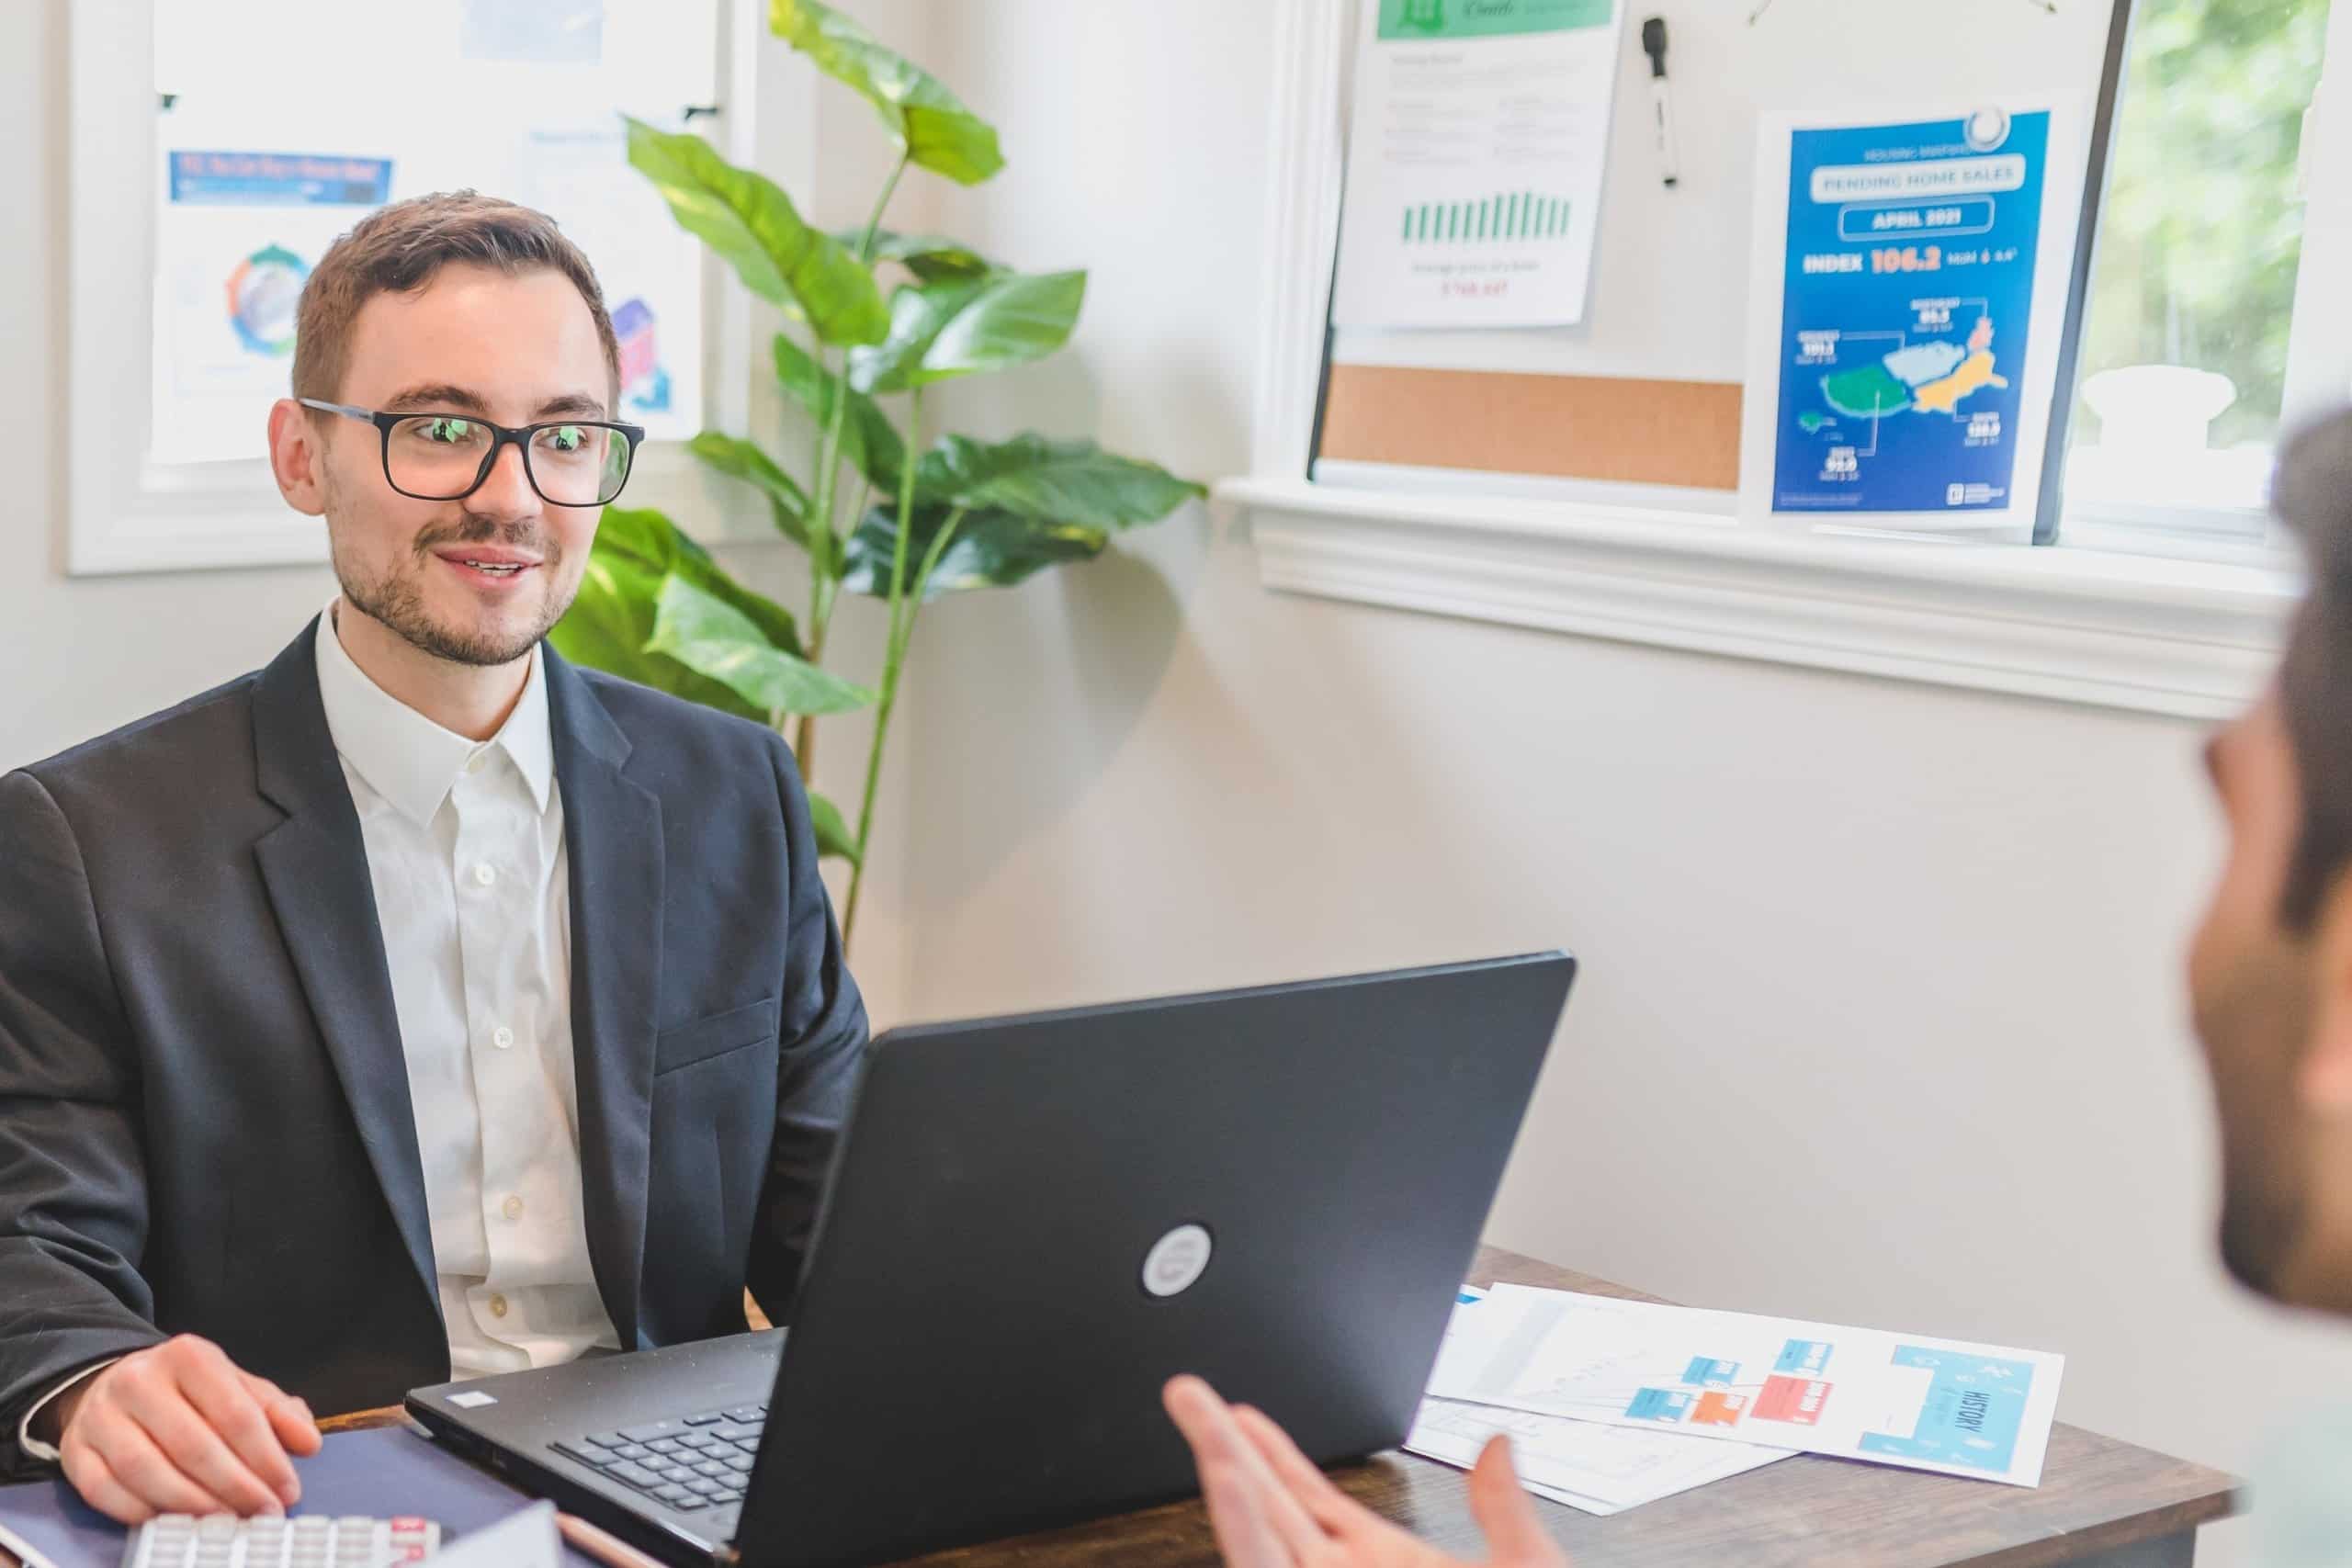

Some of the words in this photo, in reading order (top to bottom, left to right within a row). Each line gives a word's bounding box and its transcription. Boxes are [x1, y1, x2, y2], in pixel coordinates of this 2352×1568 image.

[1824, 174, 1900, 191] PENDING
[1908, 170, 1957, 186] HOME
[1962, 166, 2014, 182] SALES
[1872, 209, 1923, 230] APRIL
[1926, 207, 1962, 226] 2021
[1803, 253, 1863, 274] INDEX
[1871, 245, 1941, 274] 106.2
[1954, 1390, 1991, 1433] HISTORY
